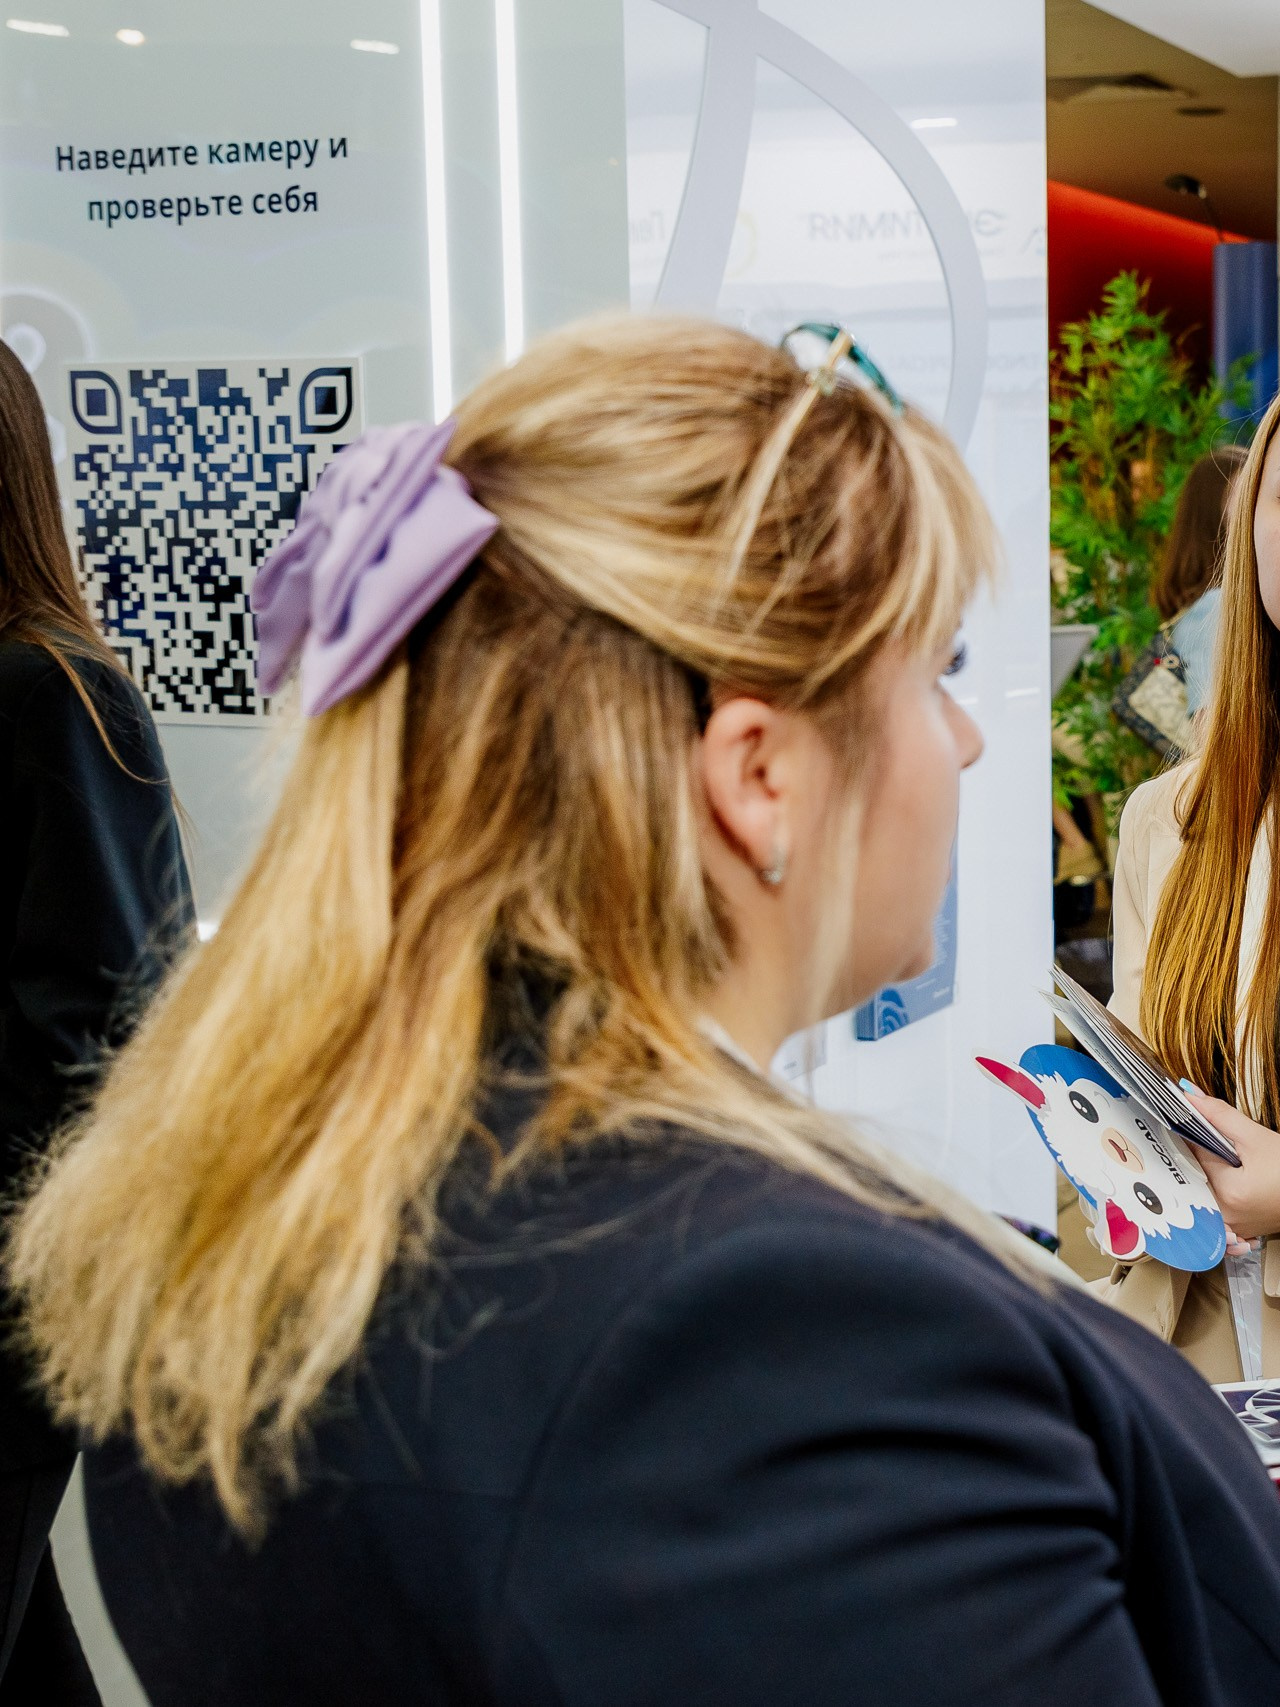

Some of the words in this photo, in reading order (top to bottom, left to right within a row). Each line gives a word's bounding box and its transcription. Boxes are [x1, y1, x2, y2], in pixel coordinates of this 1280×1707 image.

[56, 142, 199, 175] Наведите
[207, 138, 320, 167] камеру
[329, 136, 348, 159] и
[87, 193, 243, 228] проверьте
[251, 185, 320, 215] себя
